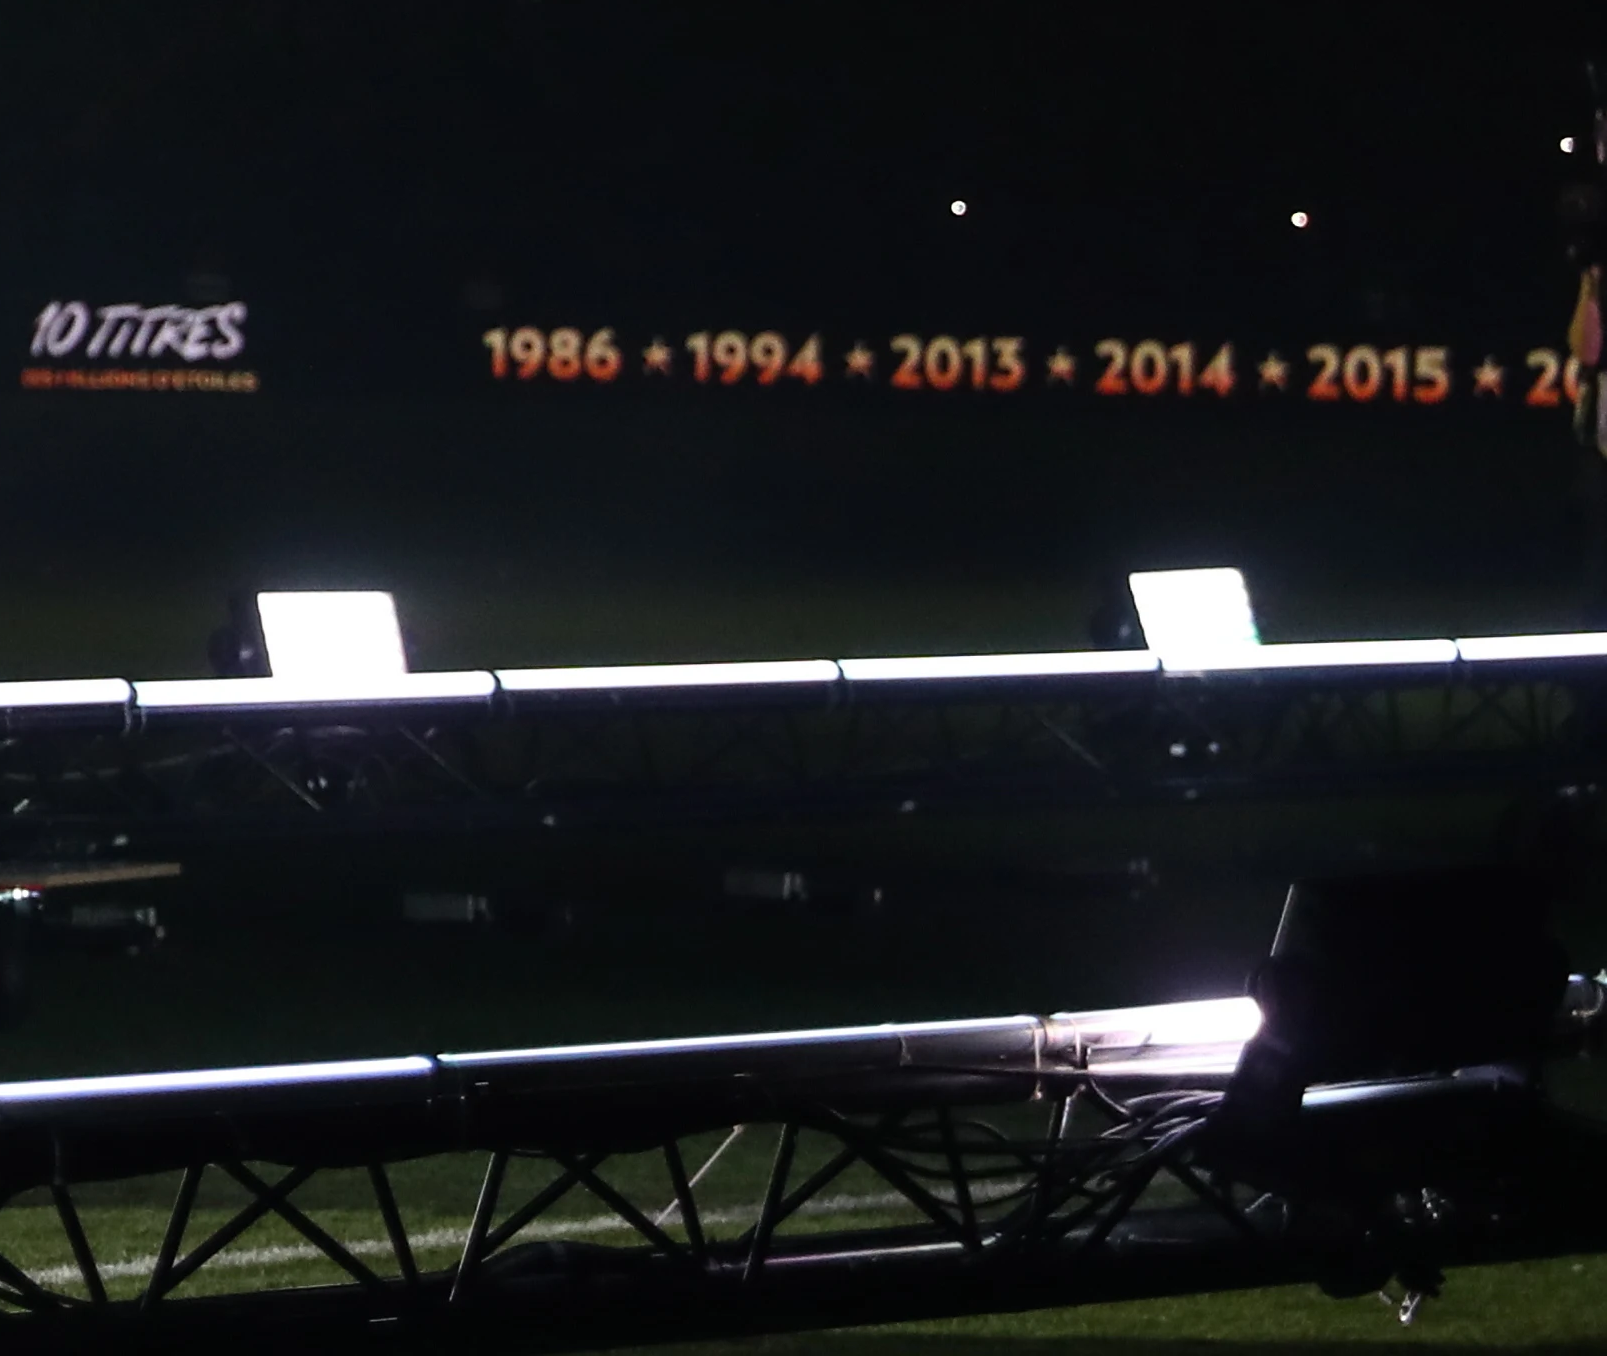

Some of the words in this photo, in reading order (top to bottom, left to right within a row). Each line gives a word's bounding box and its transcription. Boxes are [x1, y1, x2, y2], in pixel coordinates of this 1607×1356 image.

[30, 300, 90, 357] 10
[85, 300, 249, 362] TITRES
[483, 326, 623, 382] 1986
[685, 330, 823, 385] 1994
[890, 334, 1026, 391] 2013
[1095, 338, 1236, 396] 2014
[1306, 344, 1451, 404] 2015
